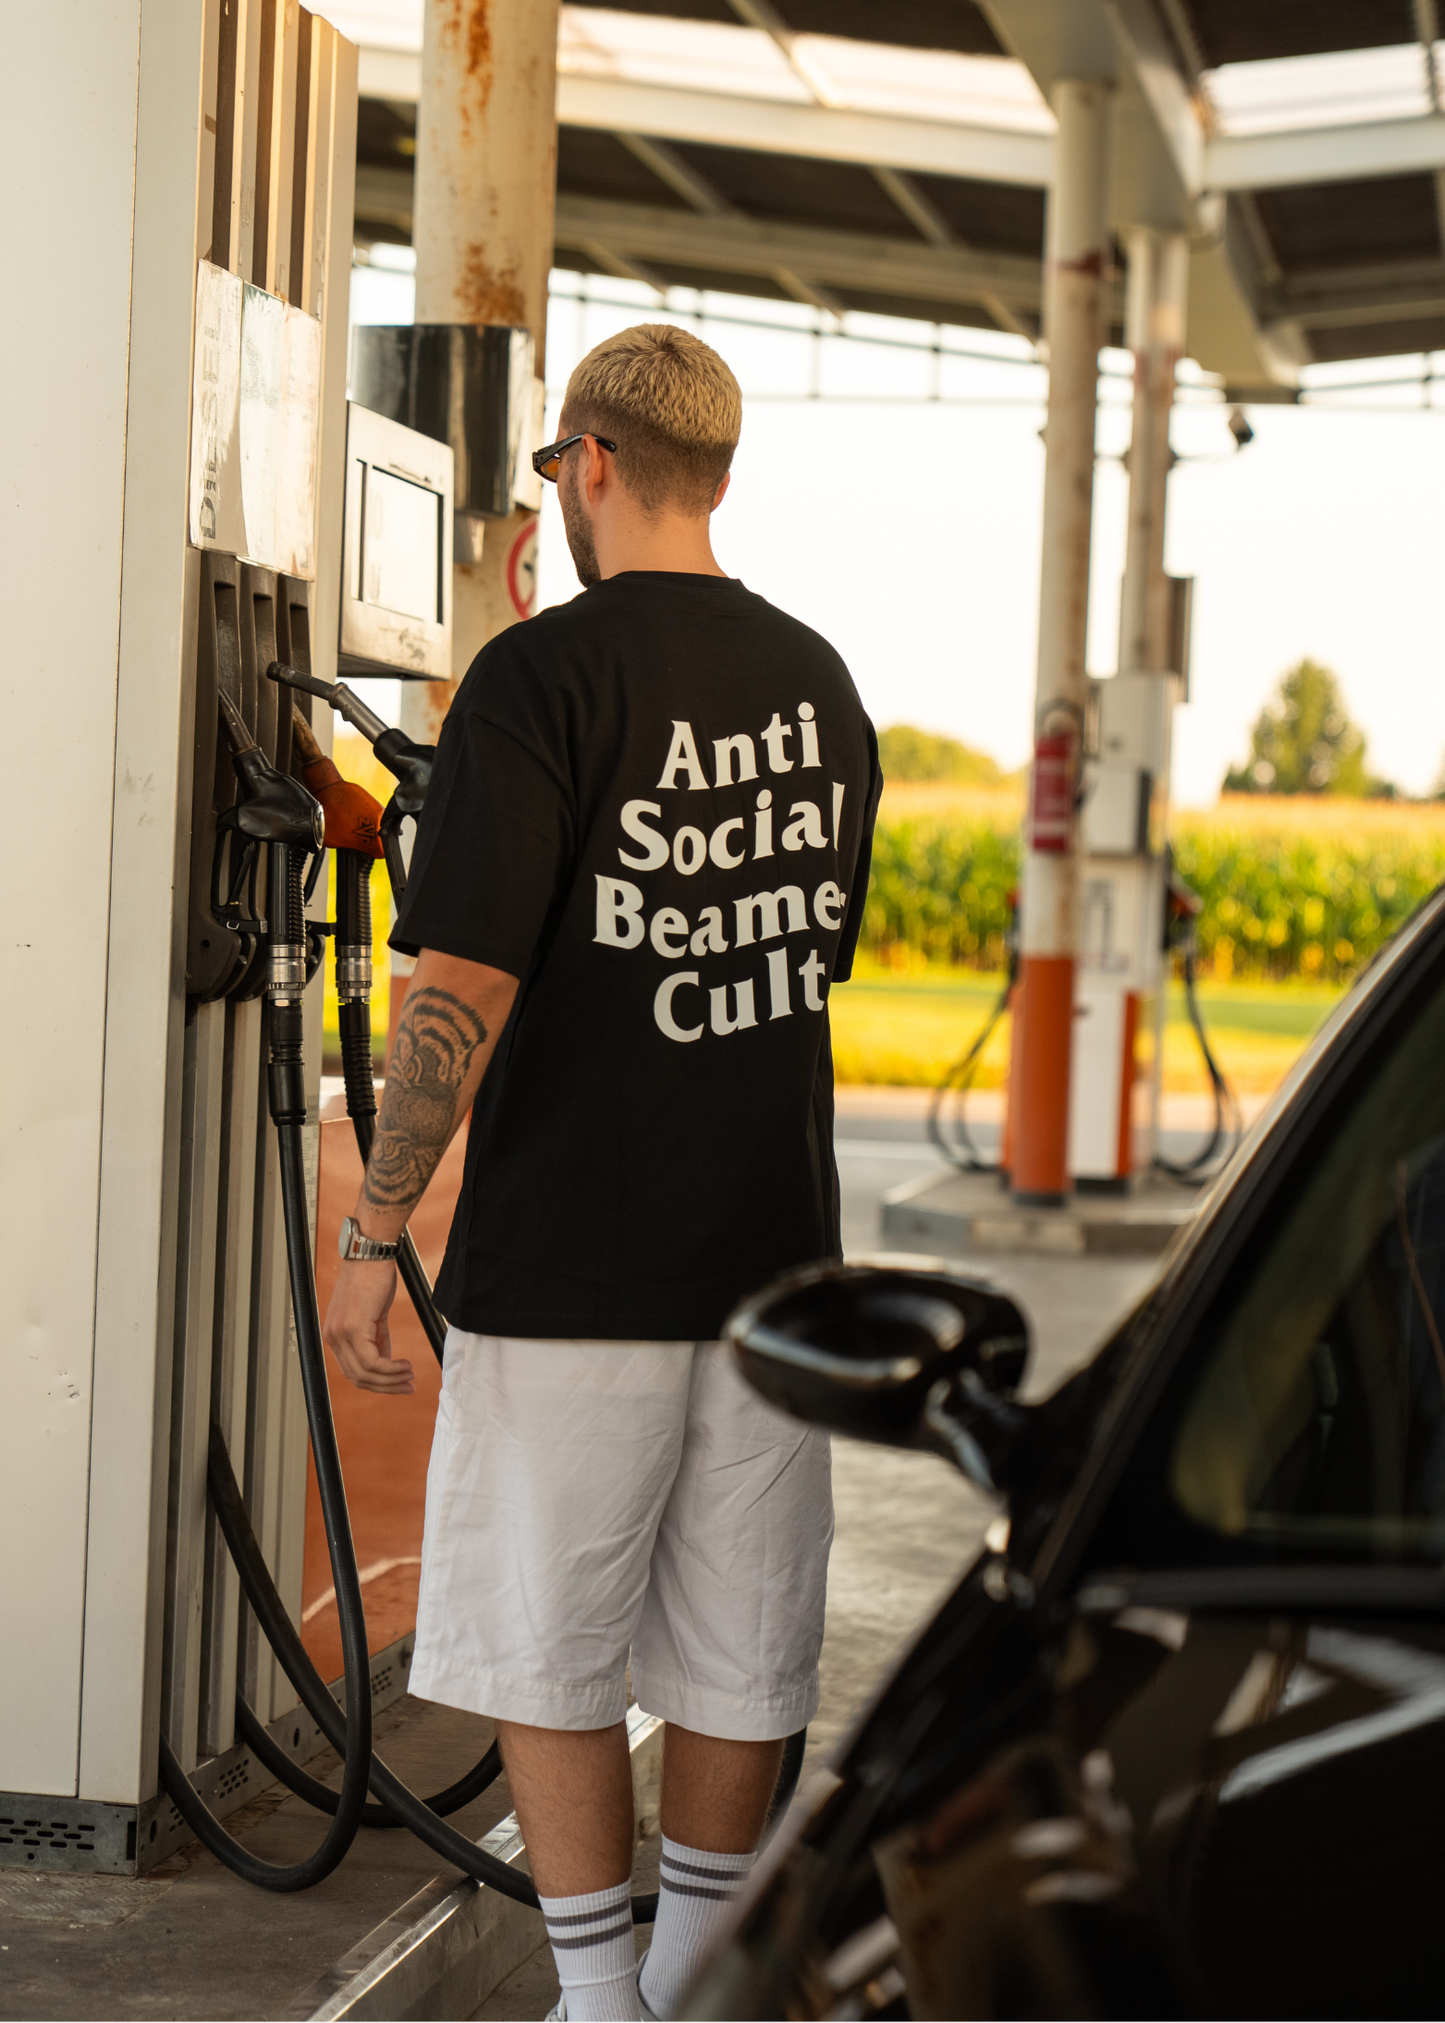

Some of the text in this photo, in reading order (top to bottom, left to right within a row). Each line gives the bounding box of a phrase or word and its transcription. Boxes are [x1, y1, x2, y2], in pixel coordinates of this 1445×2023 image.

[656, 702, 822, 790] Anti
[618, 782, 845, 875] Social
[592, 874, 847, 958] Beame
[654, 947, 825, 1042] Cult
